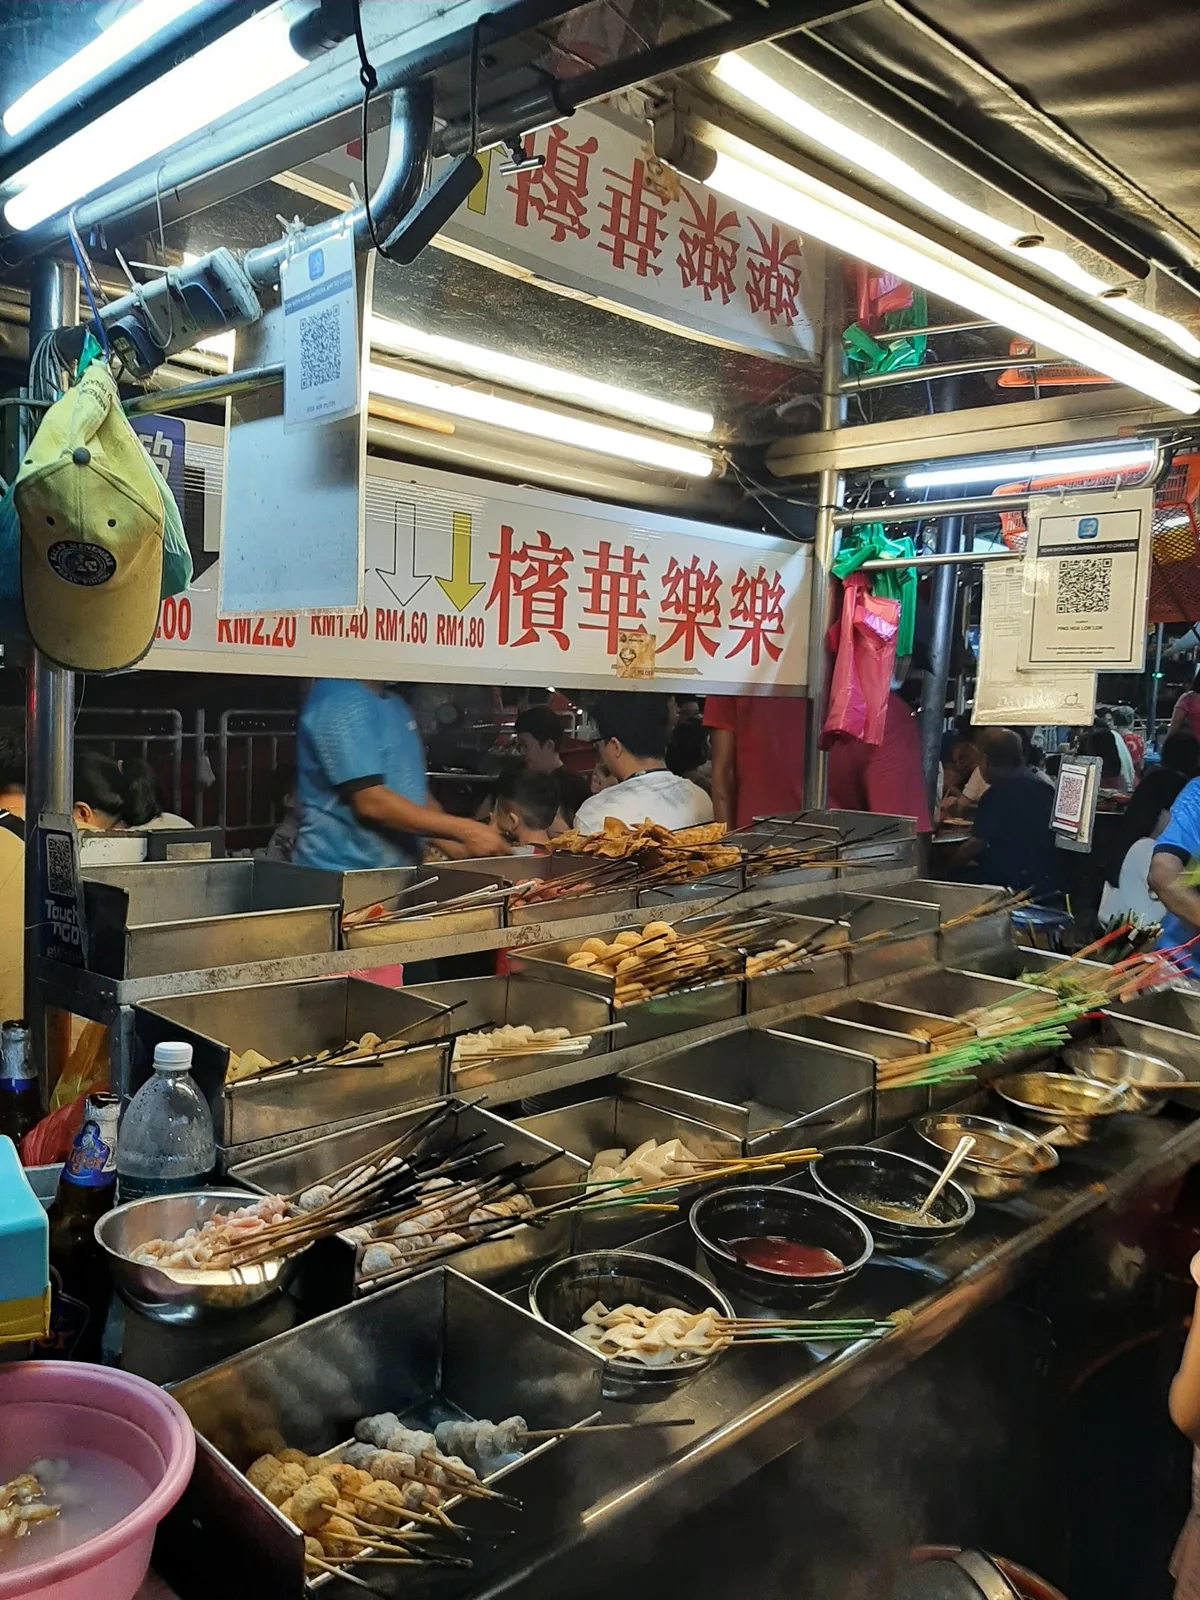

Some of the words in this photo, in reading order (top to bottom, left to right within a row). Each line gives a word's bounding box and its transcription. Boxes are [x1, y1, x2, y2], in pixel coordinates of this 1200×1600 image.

[484, 524, 786, 667] 檳華樂樂
[310, 606, 368, 640] RM1.40
[375, 607, 428, 644] RM1.60
[436, 613, 485, 648] RM1.80
[44, 899, 80, 924] Touch
